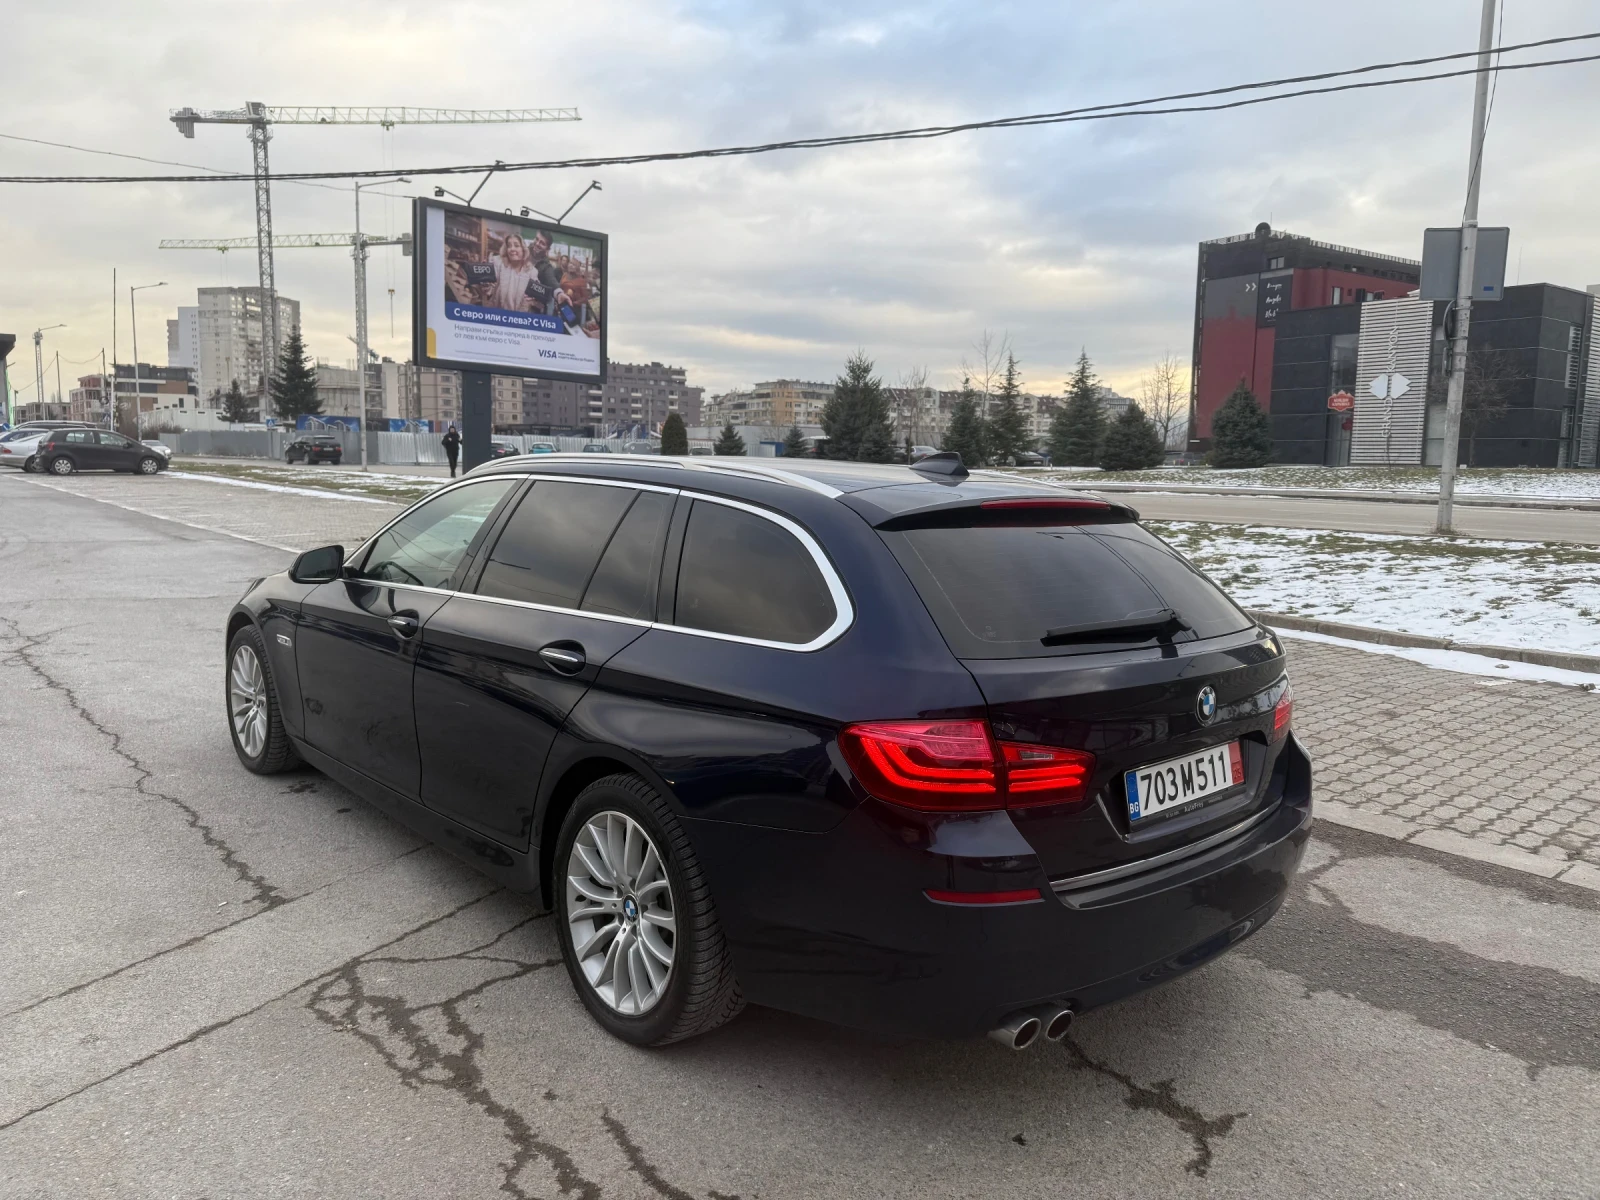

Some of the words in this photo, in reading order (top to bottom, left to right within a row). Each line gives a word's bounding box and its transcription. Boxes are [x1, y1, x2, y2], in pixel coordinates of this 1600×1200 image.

[473, 265, 491, 274] ЕВРО
[454, 308, 460, 316] С
[462, 310, 483, 319] евро
[485, 313, 501, 321] или
[508, 317, 532, 326] лева?
[533, 318, 539, 327] С
[540, 319, 557, 329] Visa
[454, 324, 482, 333] Направи
[504, 331, 525, 339] напред
[538, 349, 557, 359] VISA
[1386, 326, 1399, 373] KANYON
[1381, 397, 1393, 438] GRAND
[1129, 802, 1140, 814] BG
[1140, 751, 1227, 811] 703M511
